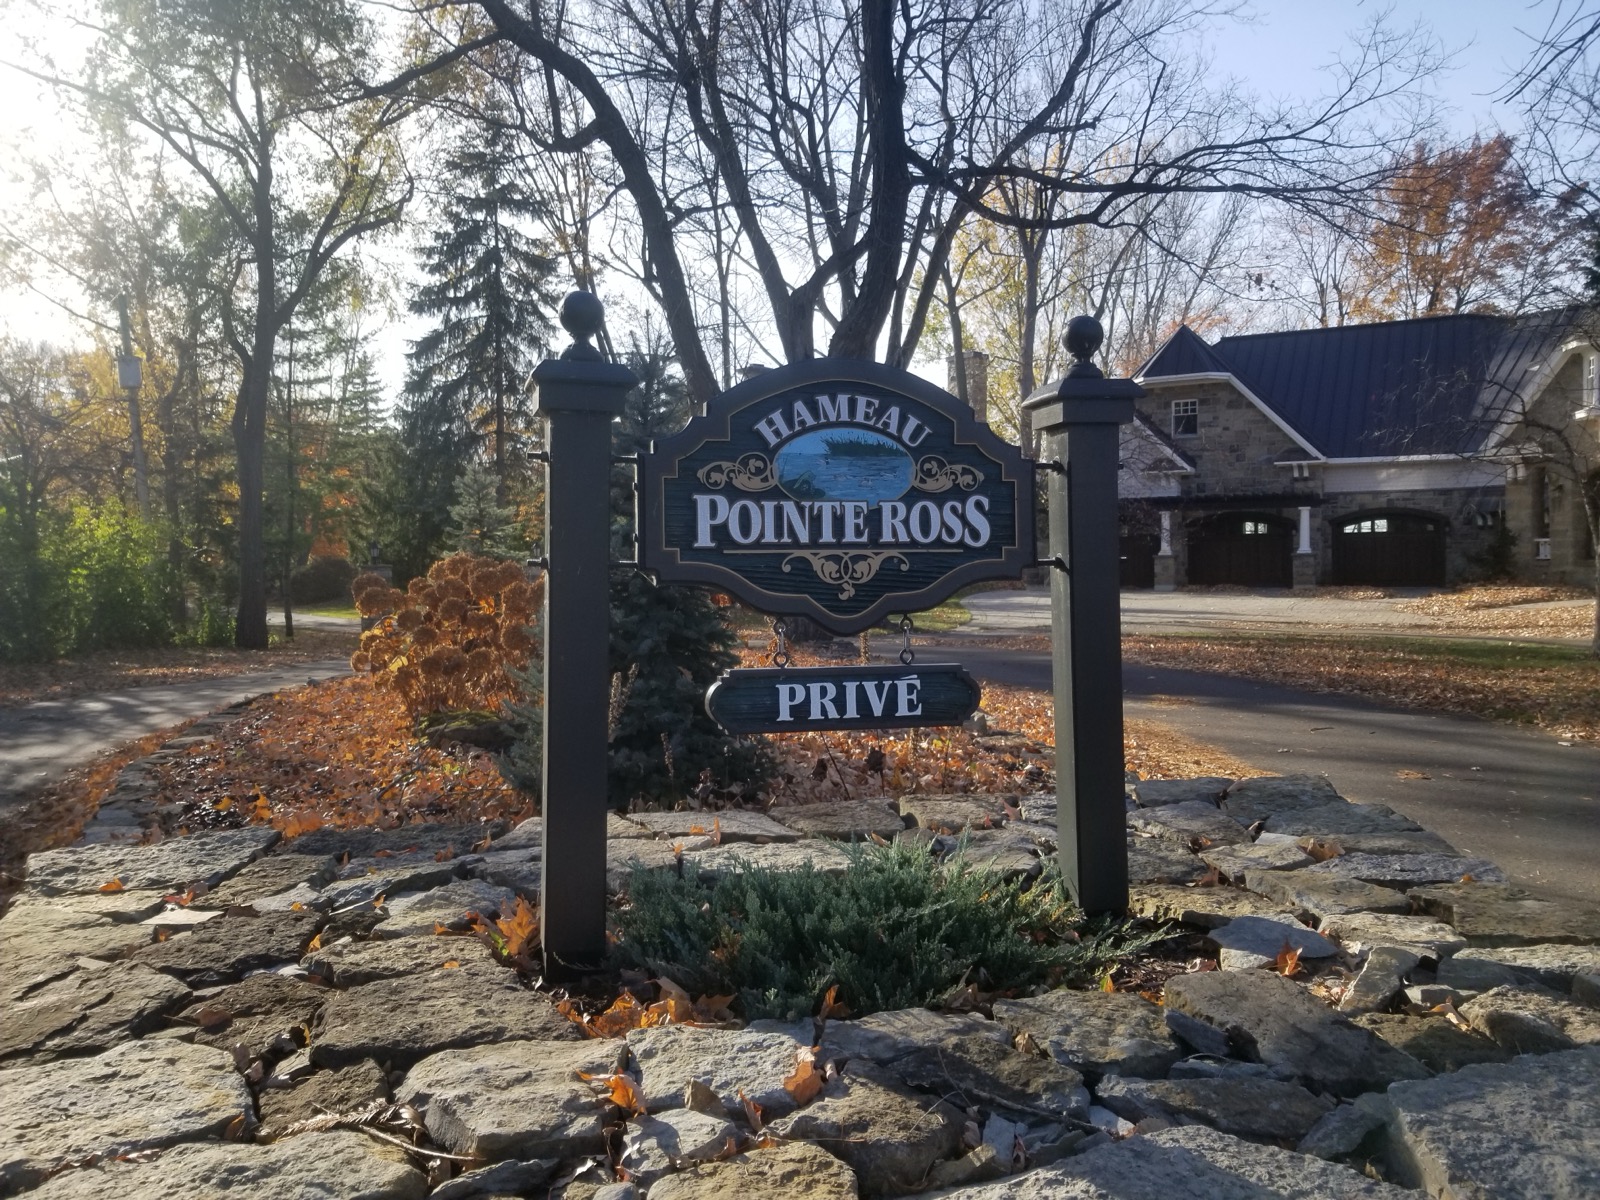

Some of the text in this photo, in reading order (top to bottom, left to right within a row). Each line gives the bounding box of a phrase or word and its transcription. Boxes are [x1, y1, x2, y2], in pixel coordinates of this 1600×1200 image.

[753, 394, 932, 447] HAMEAU
[693, 494, 991, 547] POINTE ROSS
[775, 674, 922, 721] PRIVÉ
